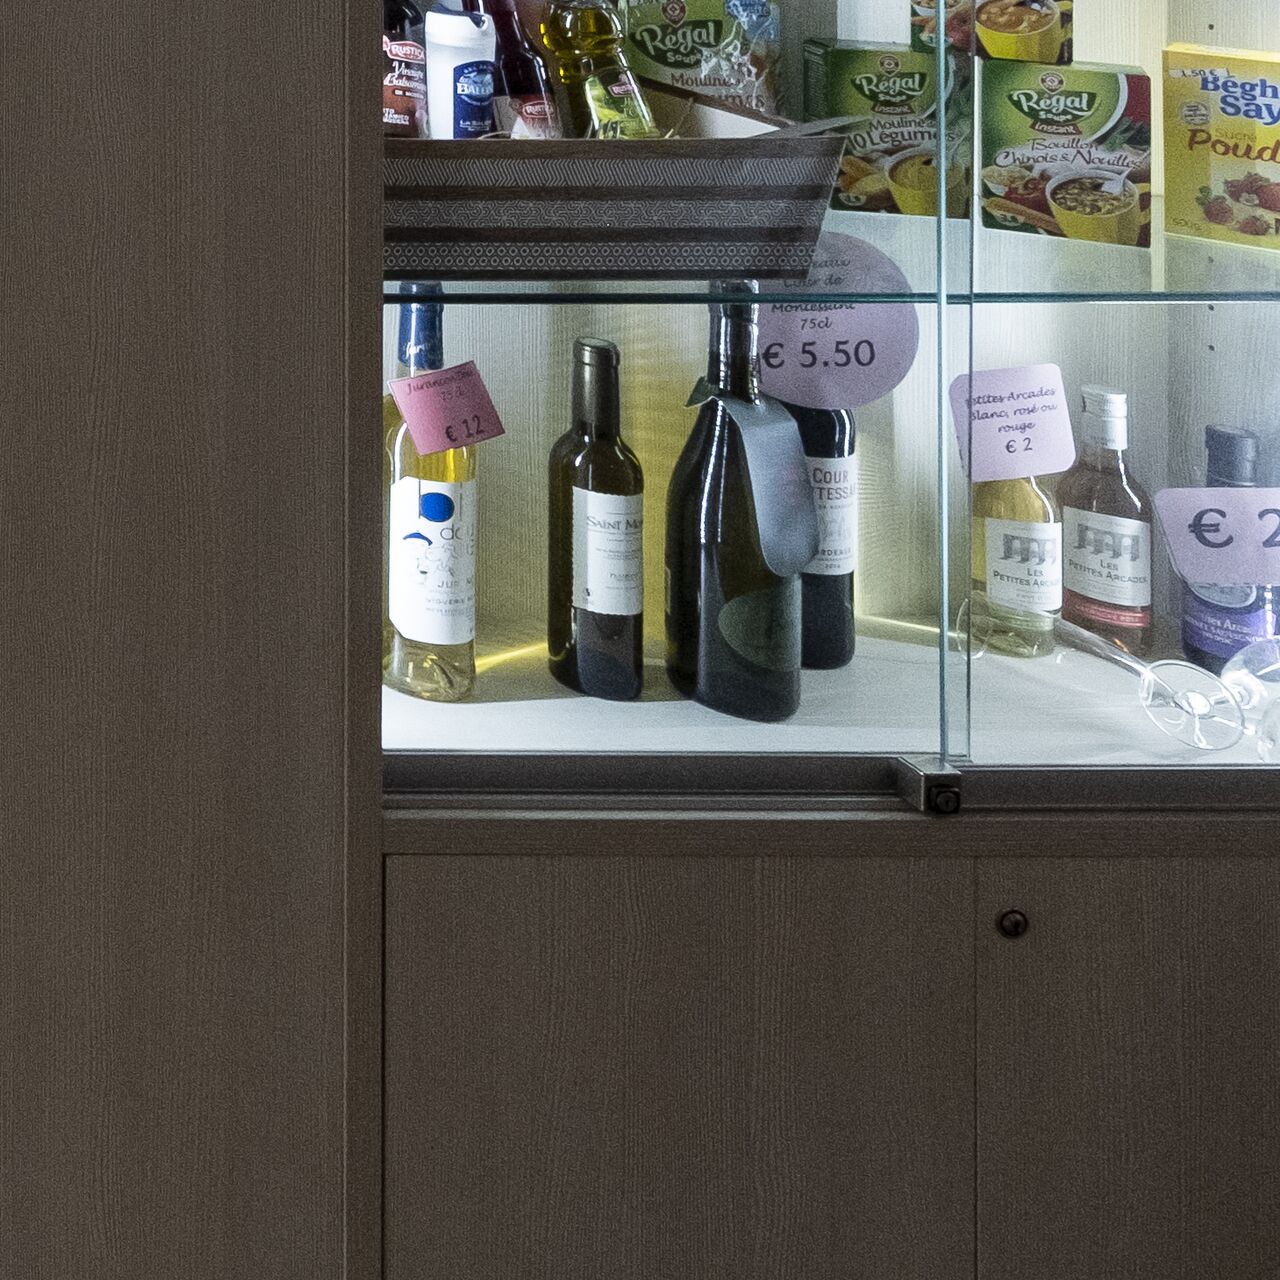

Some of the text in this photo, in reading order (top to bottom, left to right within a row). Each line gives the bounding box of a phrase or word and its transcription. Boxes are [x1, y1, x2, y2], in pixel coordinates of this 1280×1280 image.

[637, 20, 717, 55] Régal
[855, 72, 925, 97] Régal
[1012, 90, 1092, 117] Régal
[994, 150, 1058, 168] Chinois
[761, 338, 877, 370] € 5.50
[1006, 386, 1057, 402] Arcades
[444, 414, 486, 443] € 12
[997, 421, 1037, 435] rouge
[1004, 436, 1034, 454] € 2
[811, 467, 850, 485] COUR
[1187, 506, 1280, 549] € 2
[1068, 558, 1150, 584] PETITES ARCADES
[1099, 558, 1120, 572] LES
[992, 569, 1032, 587] PETITES
